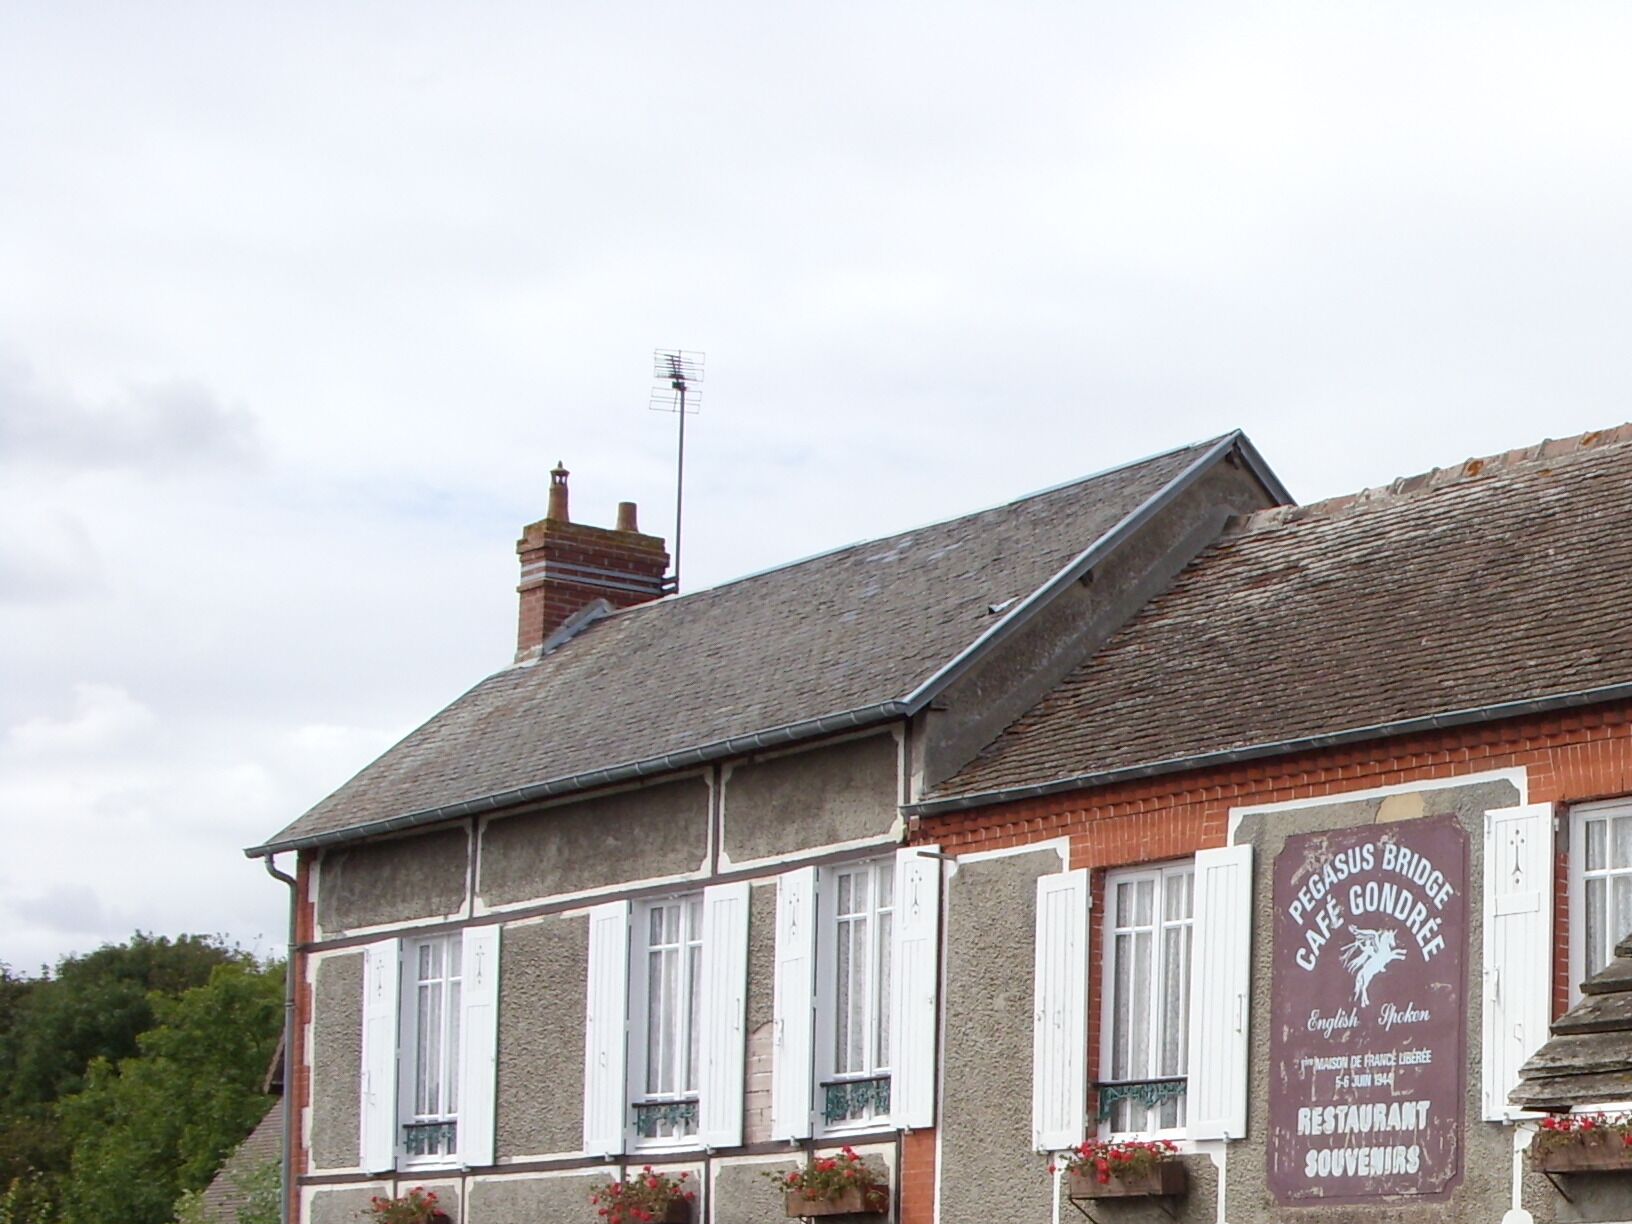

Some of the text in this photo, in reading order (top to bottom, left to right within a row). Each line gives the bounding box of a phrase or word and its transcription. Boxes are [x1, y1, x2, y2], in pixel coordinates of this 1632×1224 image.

[1289, 843, 1454, 925] PEGASUS BRIDGE
[1296, 881, 1445, 971] CAFÉ GONDRÉE
[1307, 1002, 1430, 1039] English Spoken
[1314, 1055, 1348, 1072] MAISON
[1350, 1055, 1362, 1069] DE
[1364, 1052, 1397, 1067] FRANCE
[1399, 1047, 1432, 1065] LIBÉRÉE
[1336, 1072, 1394, 1088] 5-6 JUIN 1944
[1298, 1101, 1431, 1136] RESTAURANT
[1305, 1145, 1420, 1178] SOUVENIRS
